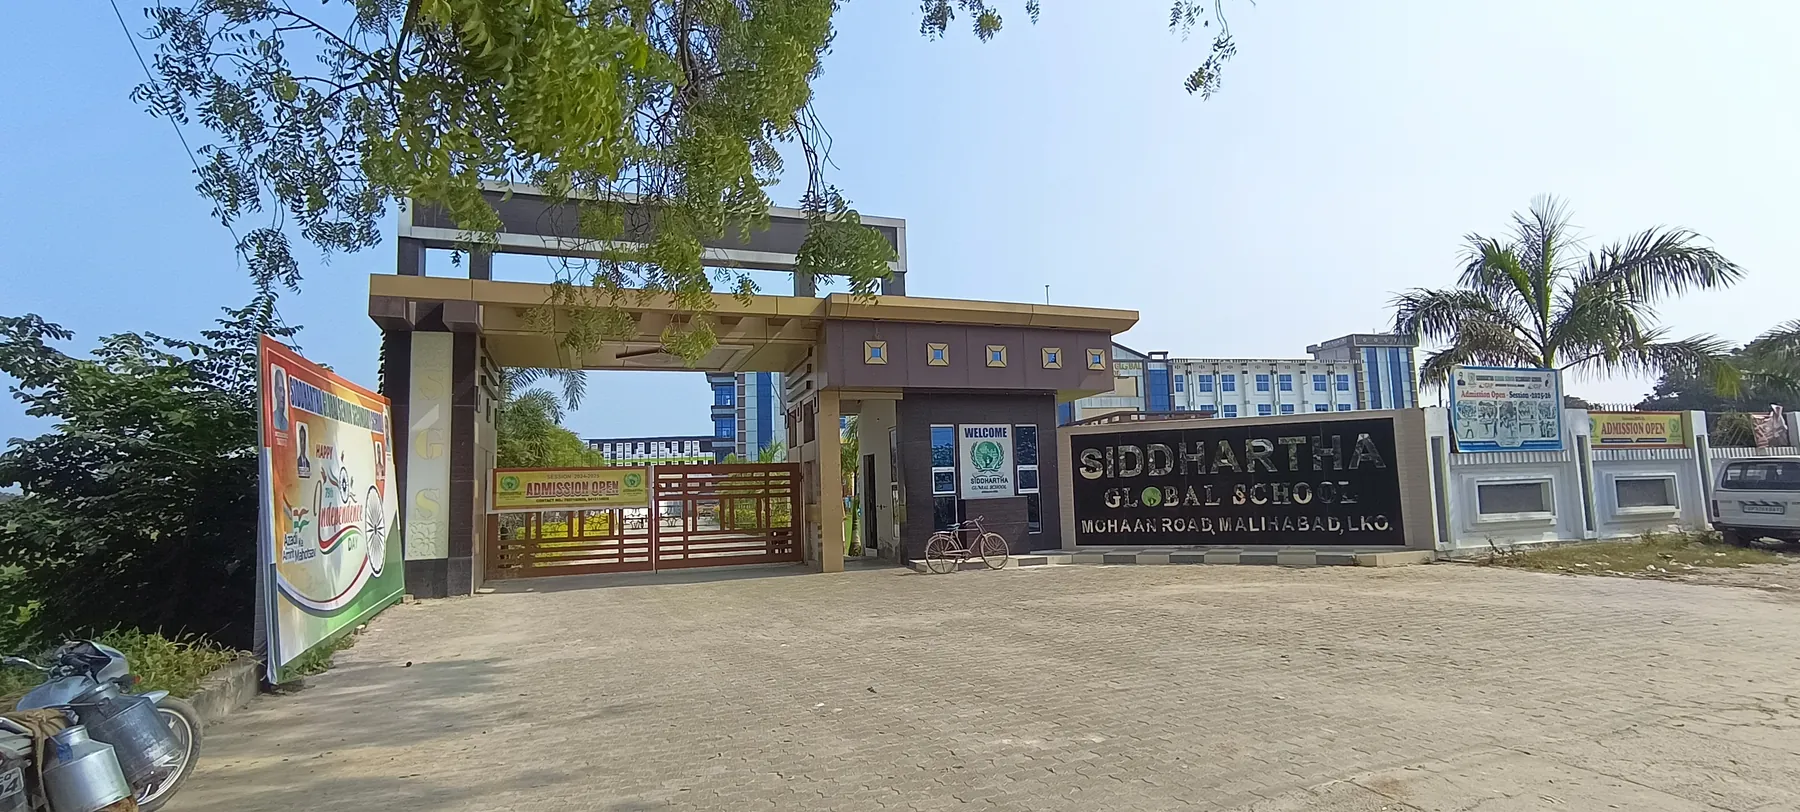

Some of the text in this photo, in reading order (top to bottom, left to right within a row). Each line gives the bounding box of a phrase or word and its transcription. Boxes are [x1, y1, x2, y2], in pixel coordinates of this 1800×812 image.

[1461, 390, 1490, 398] Admission
[1491, 391, 1506, 399] Open
[1509, 390, 1529, 398] Session
[964, 427, 1008, 438] WELCOME
[1601, 422, 1666, 435] ADMISSION OPEN
[315, 443, 334, 460] HAPPY
[1079, 433, 1386, 480] SIDDHARTHA
[526, 481, 589, 498] ADMISSION
[591, 480, 619, 496] OPEN
[1104, 484, 1221, 508] GLOBAL
[314, 480, 363, 533] Independence
[1081, 514, 1393, 535] MOHAAN ROAD, MALIHABAD, LKO.
[284, 531, 298, 546] Azadi
[347, 537, 359, 552] DAY
